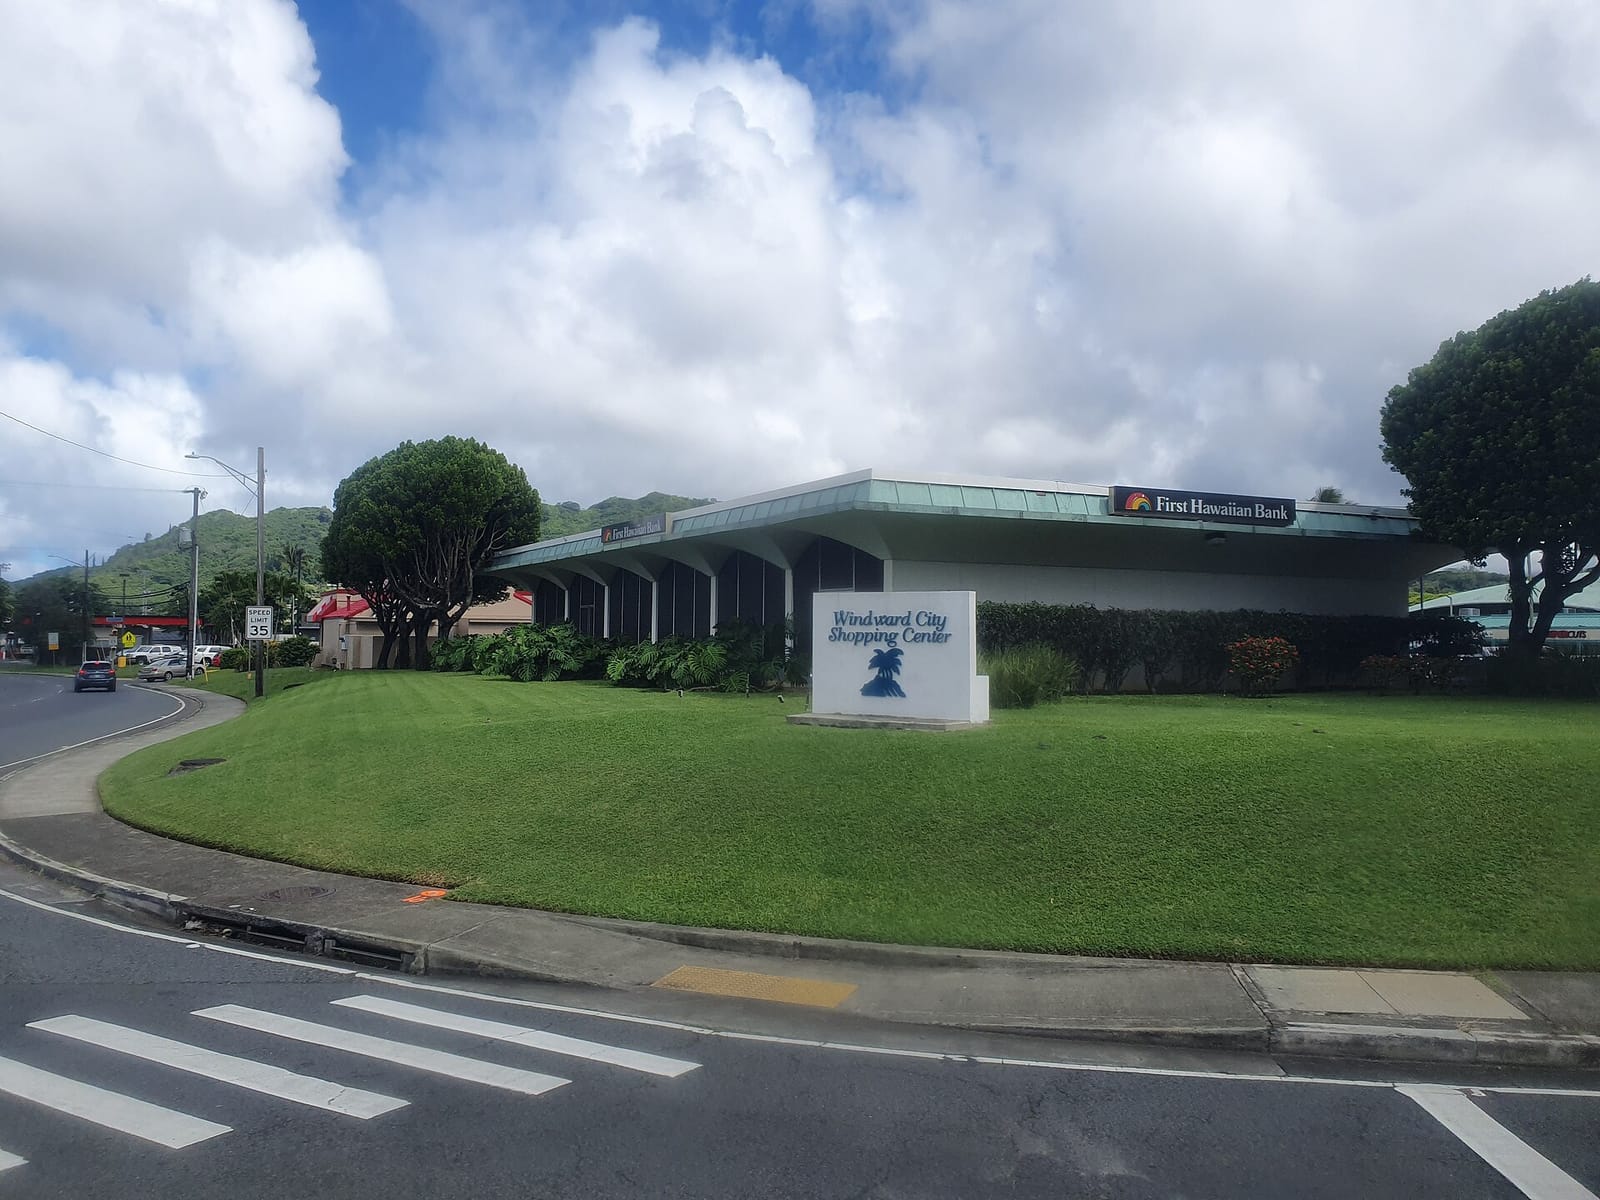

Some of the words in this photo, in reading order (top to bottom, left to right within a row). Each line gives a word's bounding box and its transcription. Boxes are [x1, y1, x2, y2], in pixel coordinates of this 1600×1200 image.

[1156, 496, 1188, 513] First
[1191, 499, 1252, 518] Hawaiian
[1255, 503, 1288, 520] Bank
[250, 625, 269, 636] 35
[833, 610, 911, 626] Windward
[915, 611, 947, 631] City
[828, 627, 899, 647] Shopping
[902, 628, 952, 643] Center
